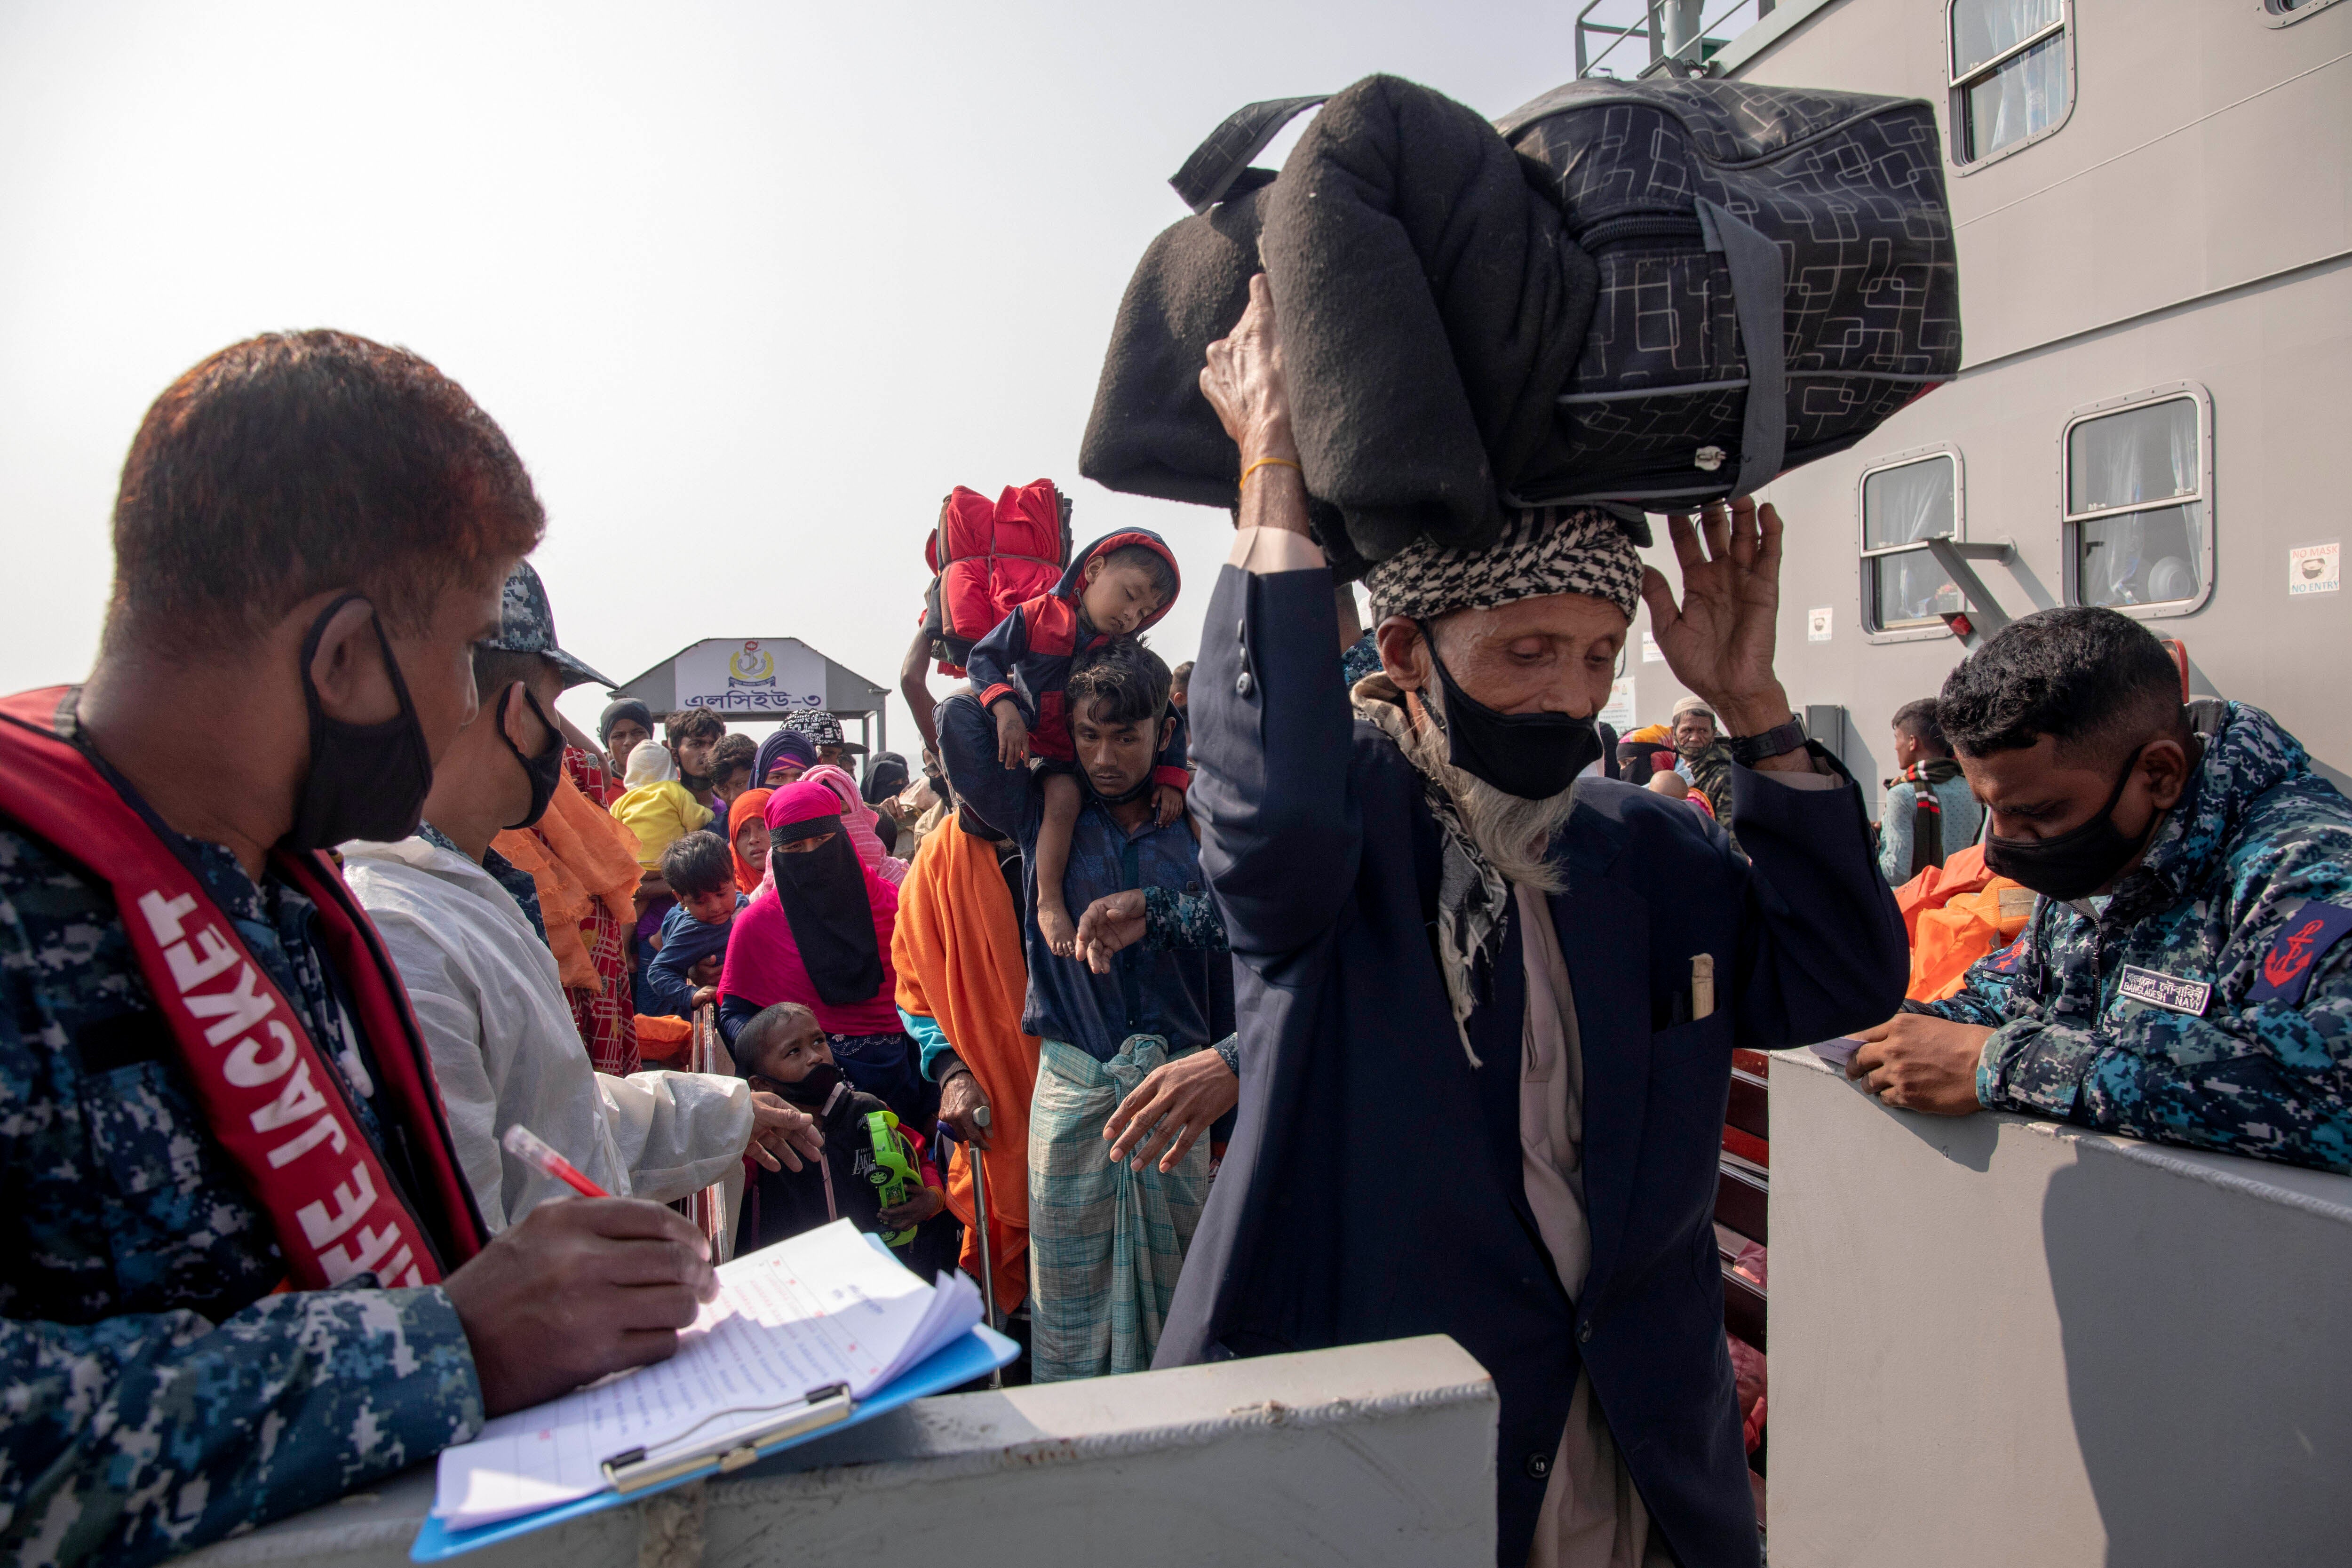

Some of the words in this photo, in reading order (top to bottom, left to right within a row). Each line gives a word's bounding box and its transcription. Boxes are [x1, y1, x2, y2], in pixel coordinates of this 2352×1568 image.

[2292, 549, 2307, 558] NO
[2310, 545, 2337, 557] MASK
[2292, 584, 2306, 593] NO
[2309, 580, 2339, 591] ENTRY
[2123, 982, 2166, 1003] BANGLADESH
[2175, 995, 2201, 1010] NAVY
[2126, 972, 2156, 989] বাংলাদেশ
[2159, 980, 2204, 1002] নৌবাহিনী
[138, 889, 348, 1170] JACKET
[296, 1160, 423, 1288] IFE
